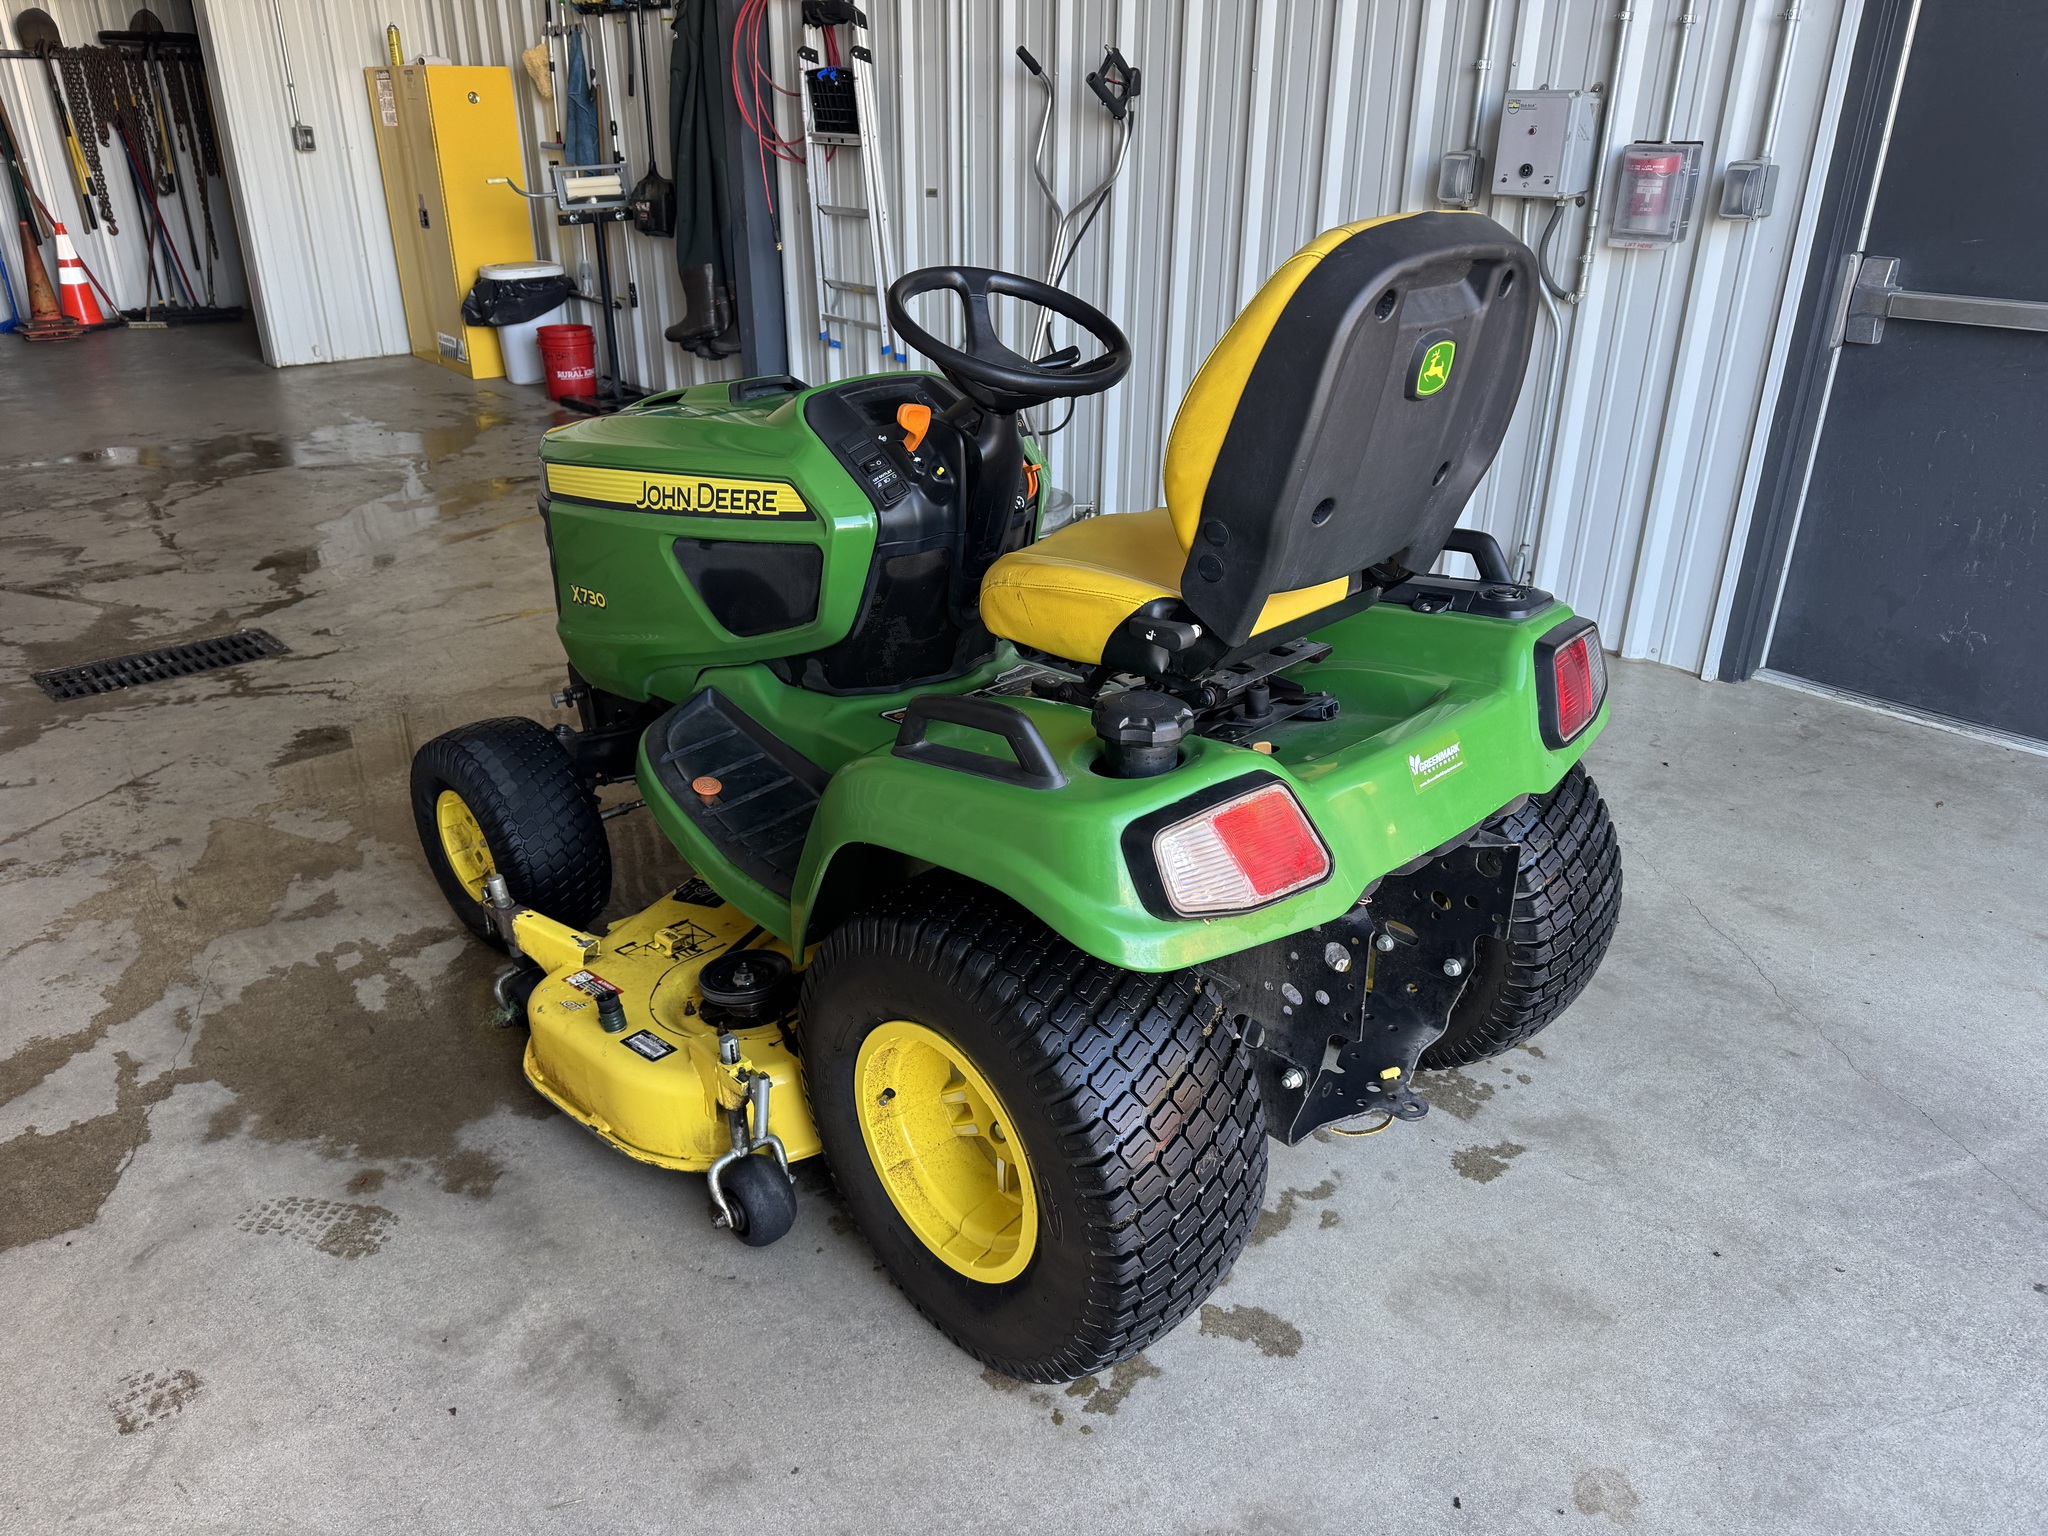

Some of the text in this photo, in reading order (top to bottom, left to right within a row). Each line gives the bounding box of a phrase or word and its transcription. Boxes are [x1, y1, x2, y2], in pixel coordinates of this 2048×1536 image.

[557, 370, 583, 378] RURAL
[636, 480, 778, 513] JOHN DEERE
[570, 584, 607, 608] X730
[1420, 742, 1461, 772] GREENMARK
